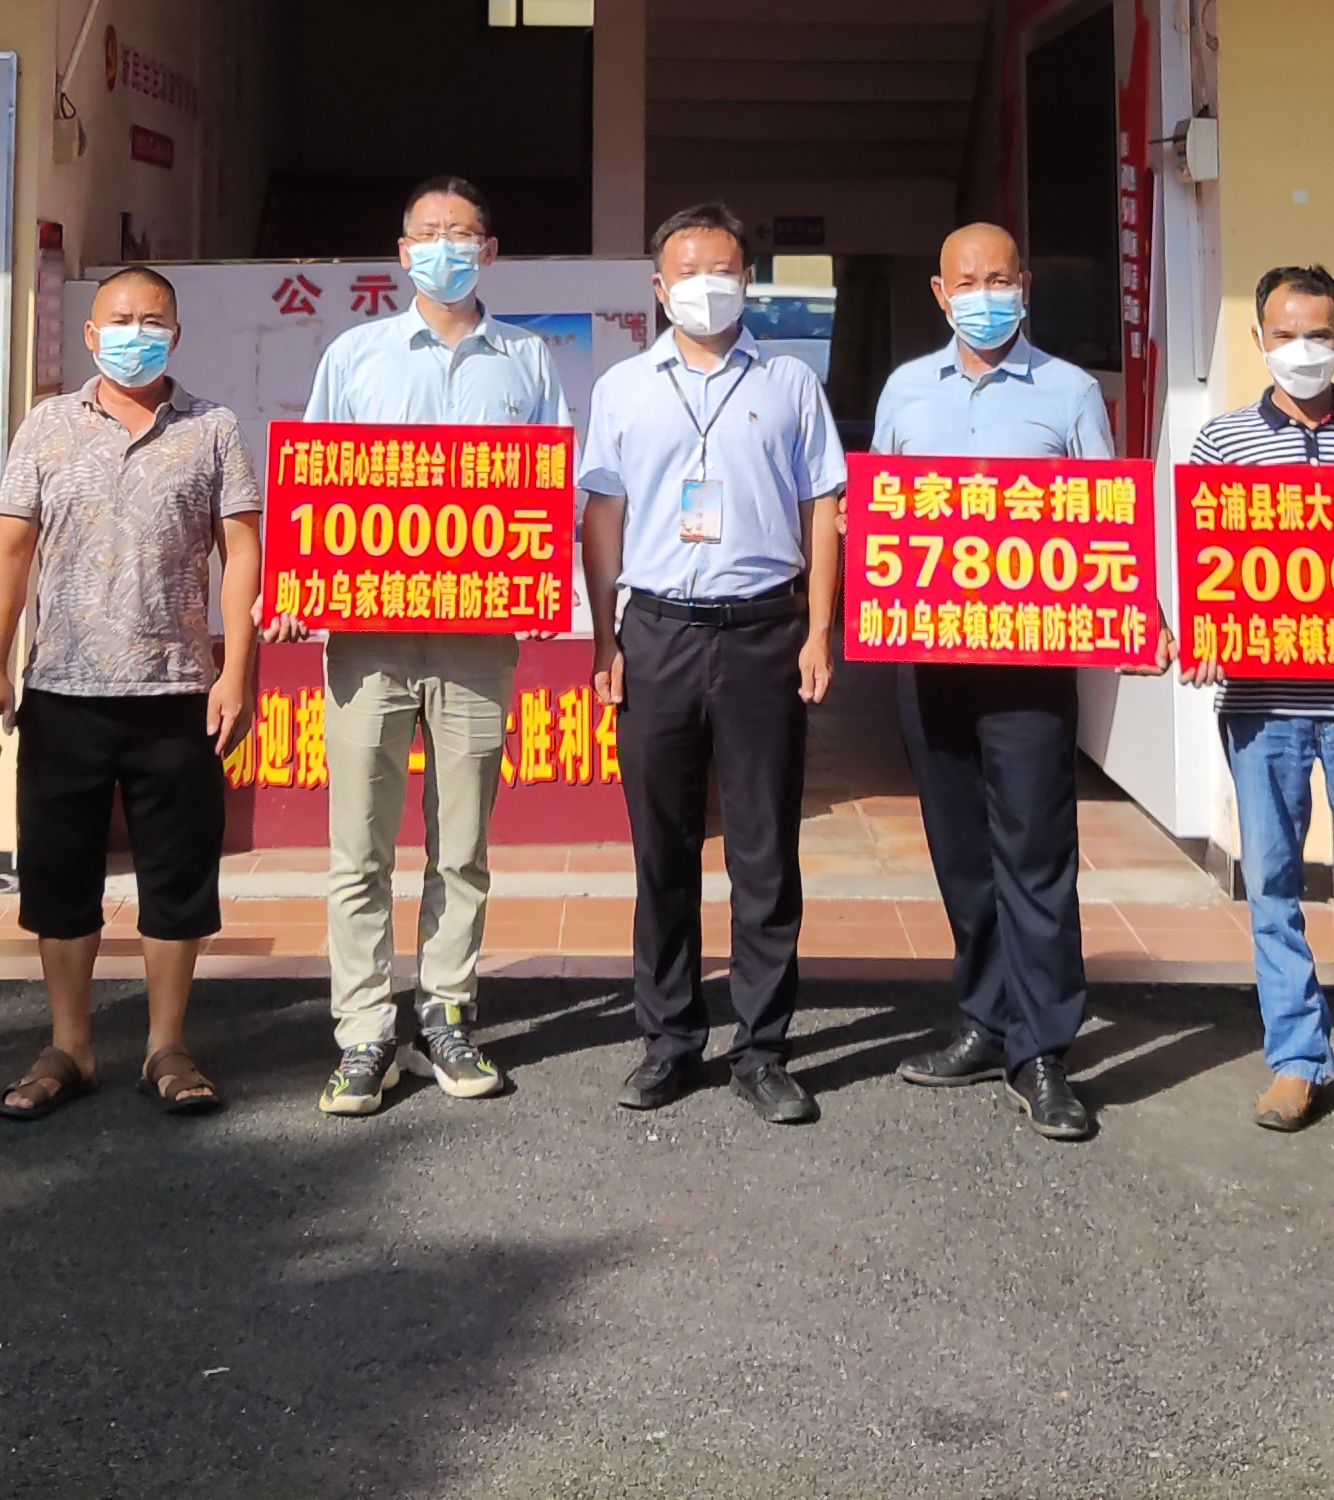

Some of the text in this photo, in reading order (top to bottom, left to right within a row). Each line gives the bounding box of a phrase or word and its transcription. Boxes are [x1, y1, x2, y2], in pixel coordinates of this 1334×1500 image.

[271, 273, 400, 317] 公示
[867, 470, 1137, 525] 乌家商会捐赠
[289, 502, 555, 562] 100000元
[864, 534, 1140, 593] 57800元
[274, 568, 563, 621] 助力乌家镇疫情防控工作
[858, 598, 1147, 654] 助力乌家镇疫情防控工作
